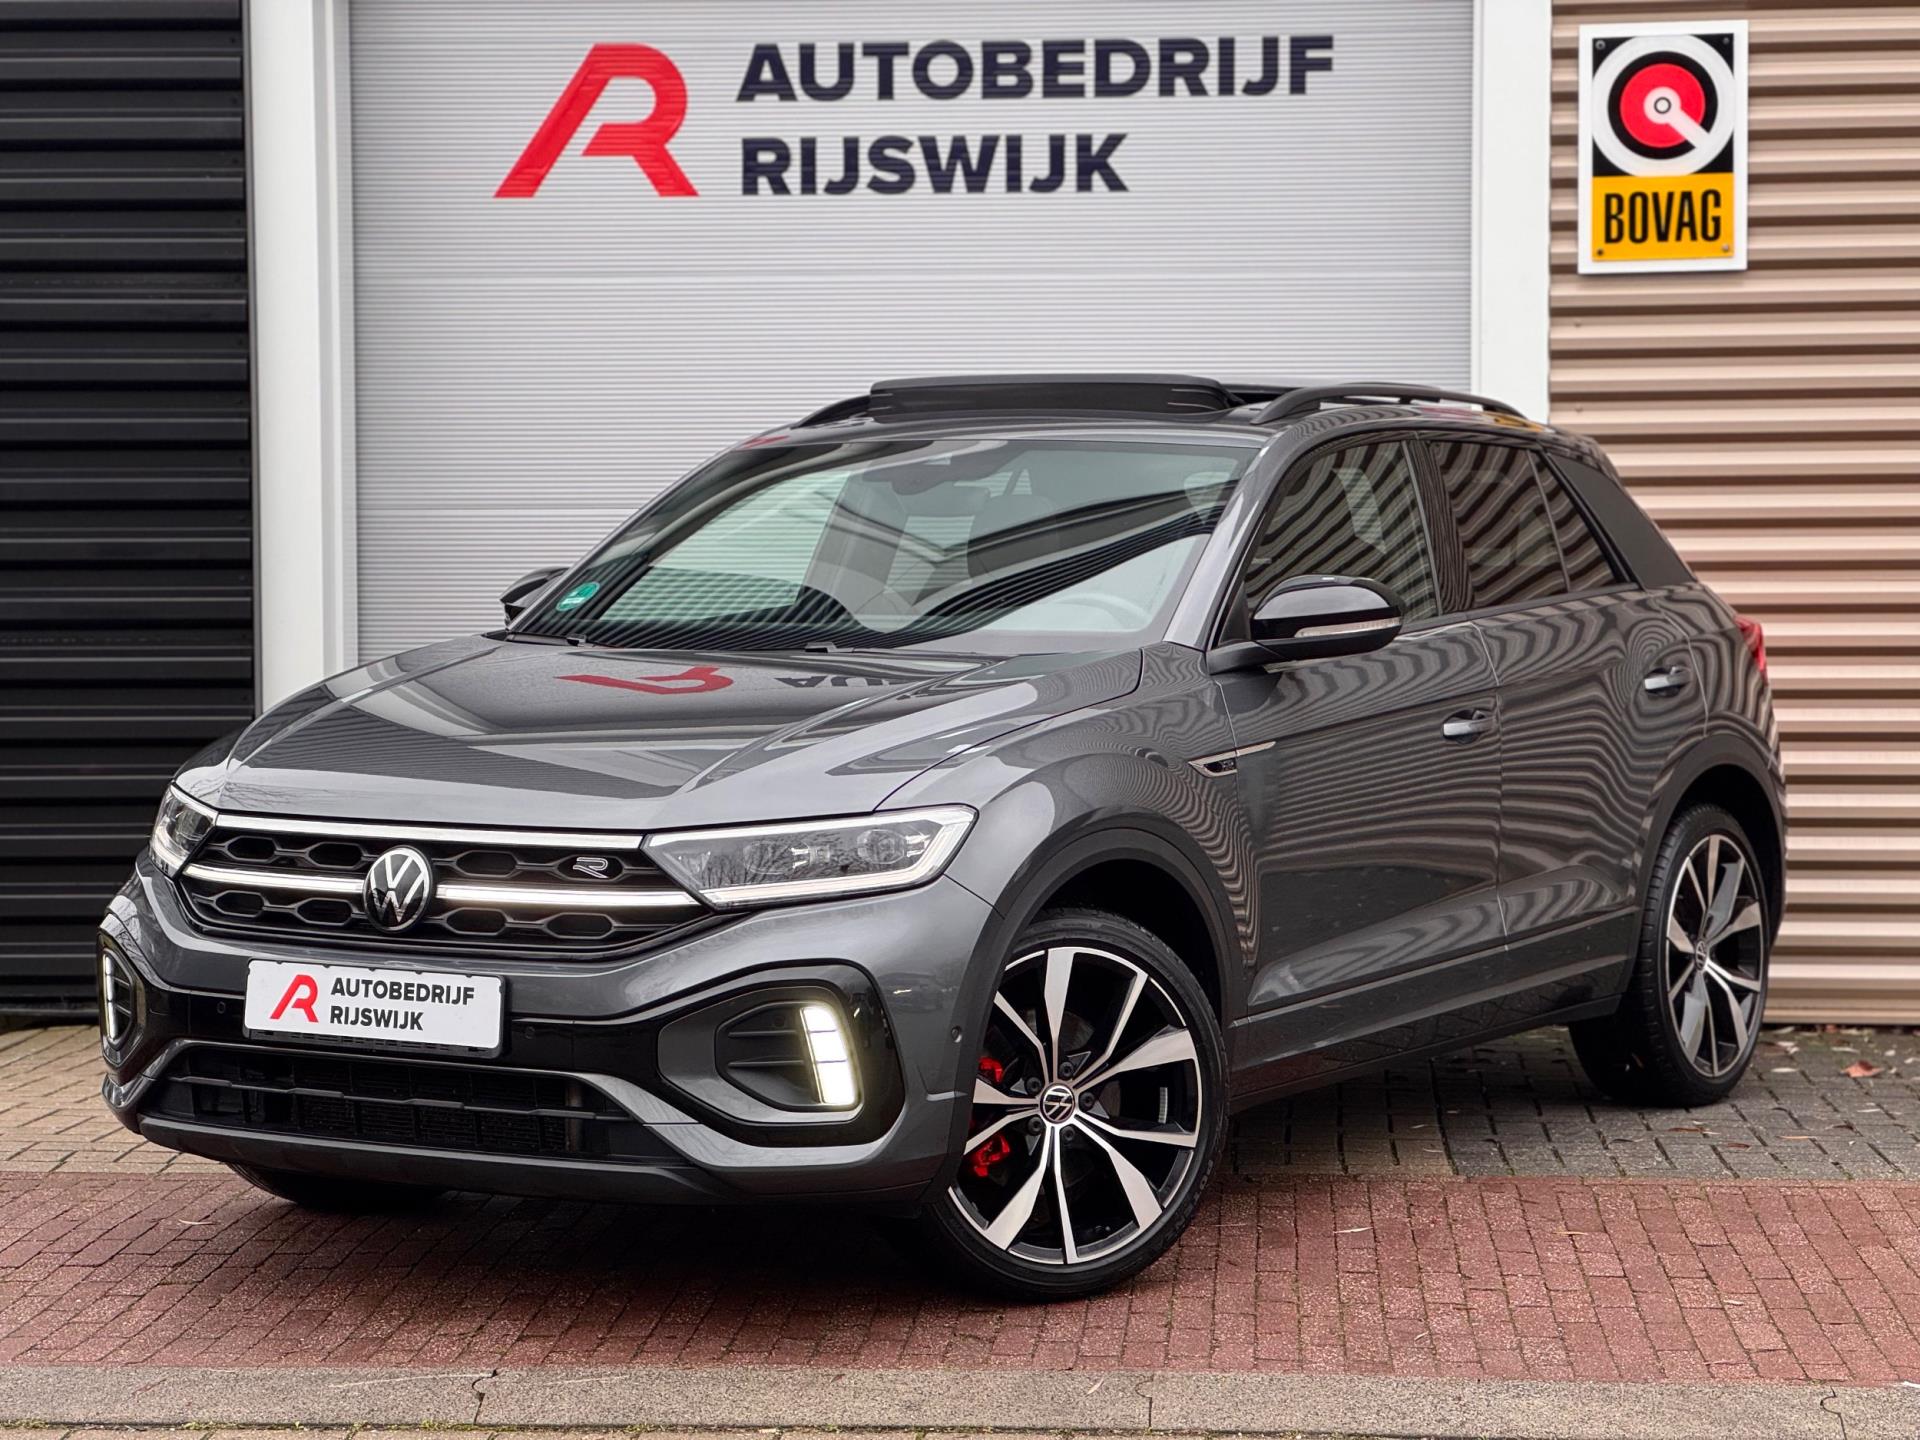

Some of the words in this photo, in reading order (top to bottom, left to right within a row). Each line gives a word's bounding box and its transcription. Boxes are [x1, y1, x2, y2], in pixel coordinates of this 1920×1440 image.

[737, 35, 1334, 102] AUTOBEDRIJF
[742, 134, 1128, 196] RIJSWIJK
[1604, 189, 1721, 244] BOVAG
[329, 1005, 424, 1031] RIJSWIJK
[330, 977, 475, 1006] AUTOBEDRIJF
